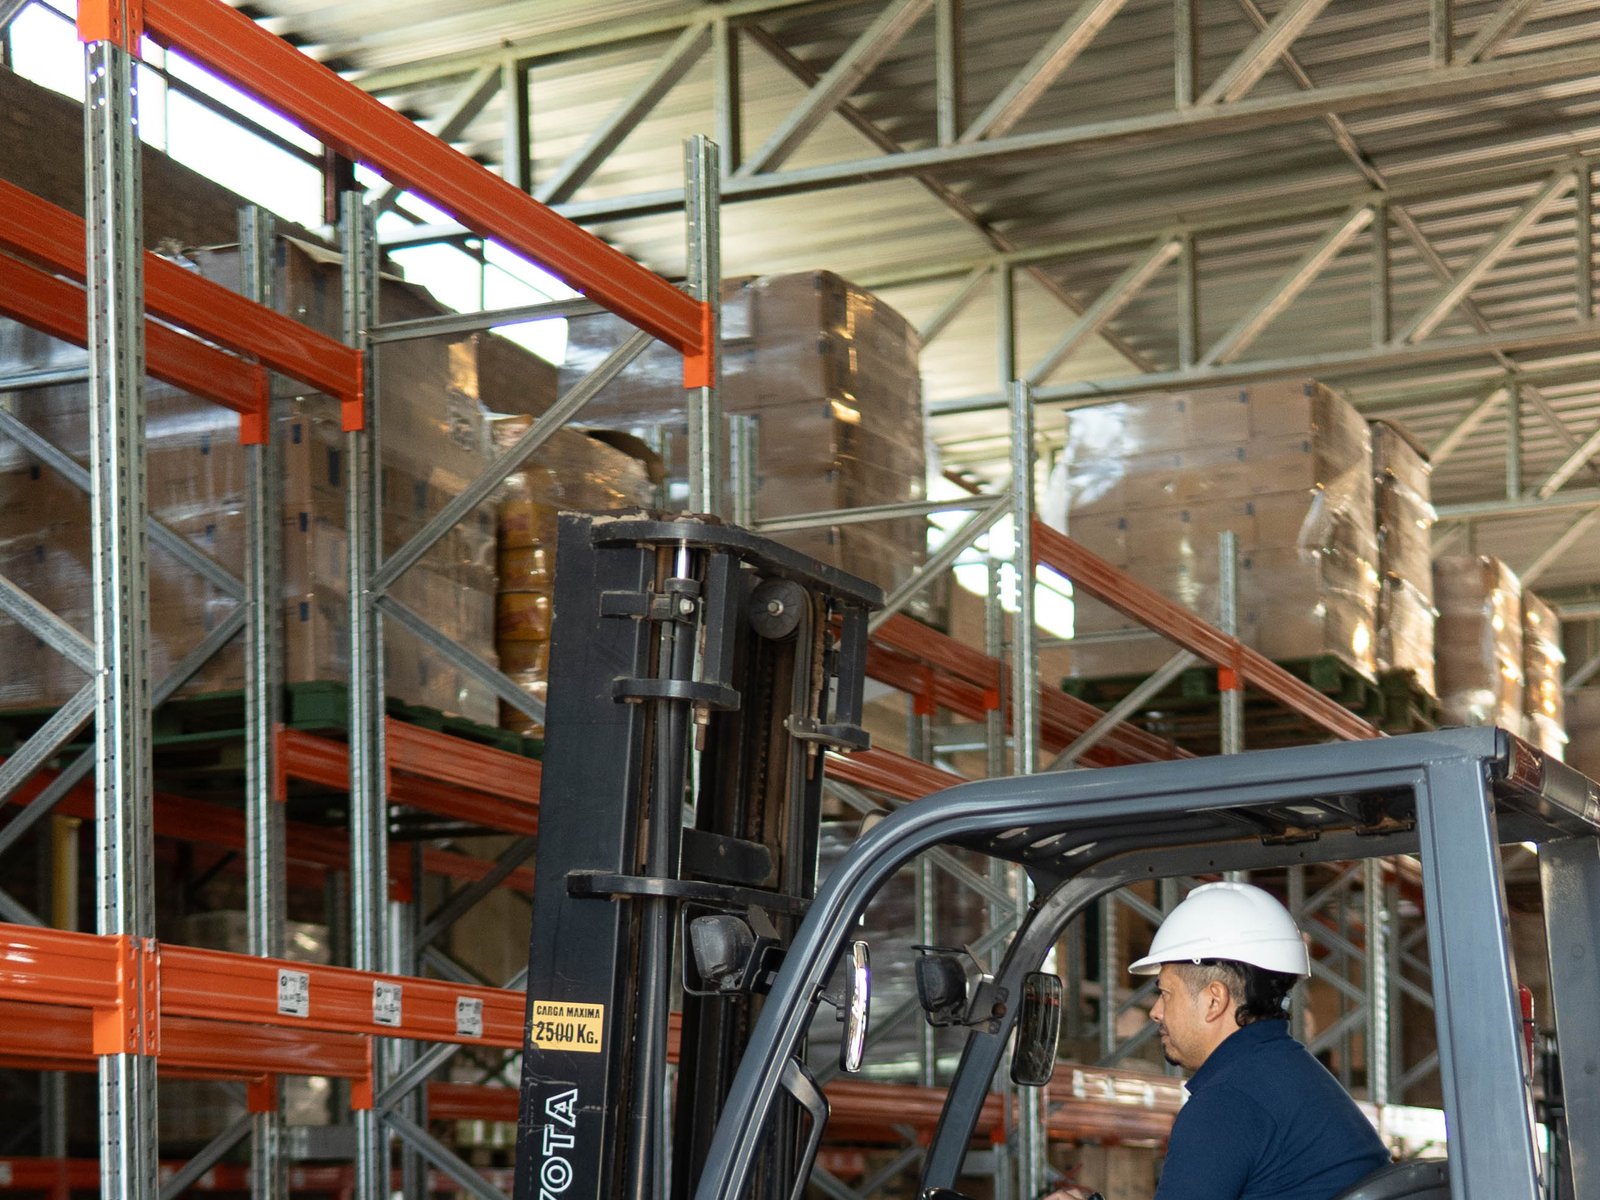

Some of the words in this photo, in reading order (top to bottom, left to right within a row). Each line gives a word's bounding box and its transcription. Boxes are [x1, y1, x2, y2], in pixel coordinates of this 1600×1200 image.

[537, 1005, 564, 1017] CARGA
[566, 1007, 600, 1019] MAXIMA
[536, 1021, 574, 1042] 2500
